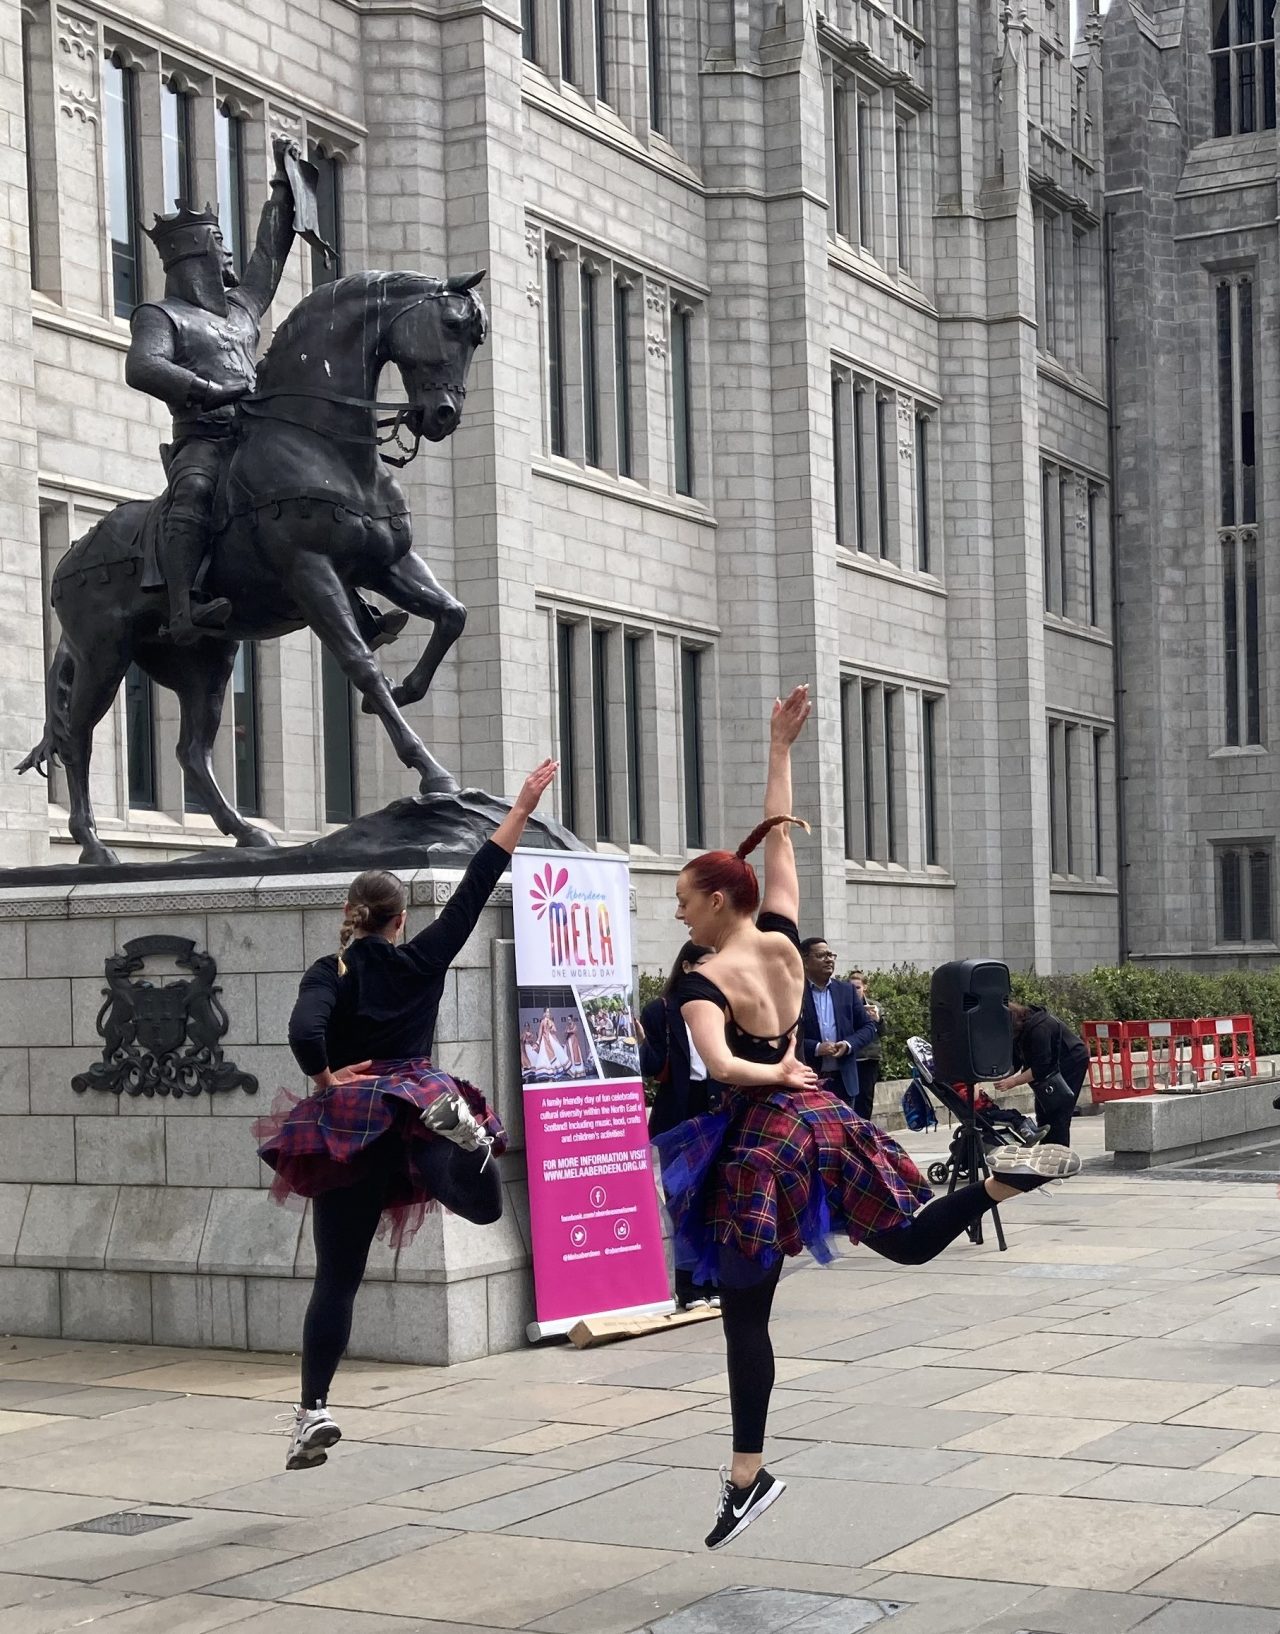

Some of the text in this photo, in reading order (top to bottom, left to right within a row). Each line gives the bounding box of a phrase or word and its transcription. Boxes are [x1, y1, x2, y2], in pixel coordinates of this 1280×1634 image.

[549, 902, 613, 966] MELA
[552, 969, 614, 978] ONE WORLD DAY
[584, 1095, 594, 1105] day
[595, 1094, 601, 1103] of
[602, 1094, 610, 1102] fun
[611, 1092, 640, 1101] celebrating
[560, 1108, 582, 1118] diversity
[600, 1106, 610, 1114] the
[610, 1104, 626, 1114] North
[626, 1104, 638, 1112] East
[626, 1115, 641, 1124] crafts
[561, 1134, 572, 1144] and
[543, 1149, 646, 1170] FOR MORE INFORMATION VISIT
[544, 1160, 648, 1181] WWW.MELAABERDEEN.ORG.UK
